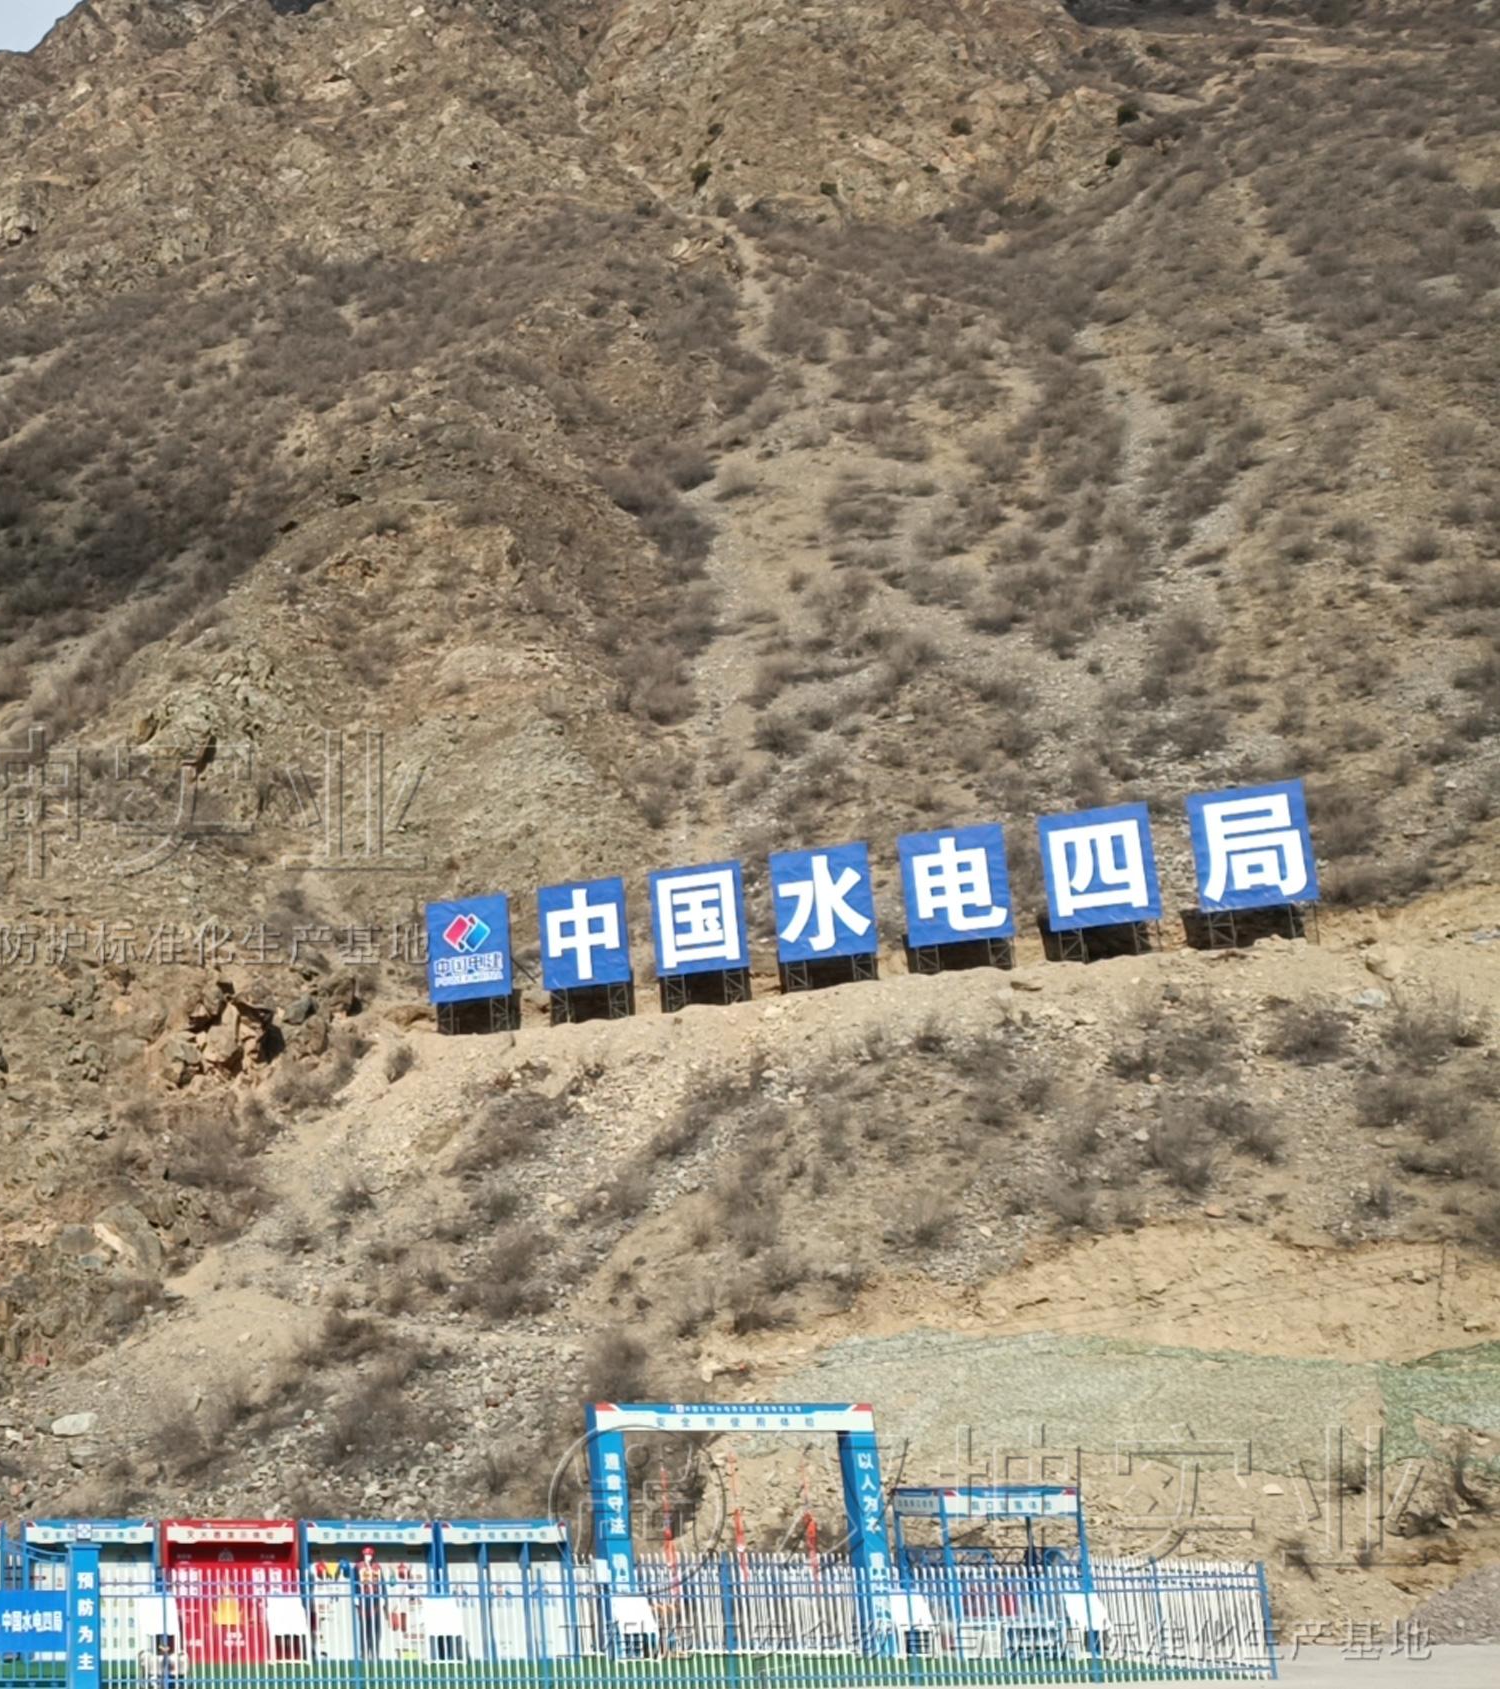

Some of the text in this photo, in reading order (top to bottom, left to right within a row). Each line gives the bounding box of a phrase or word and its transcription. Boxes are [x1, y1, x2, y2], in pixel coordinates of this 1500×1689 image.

[546, 793, 1308, 980] 中国水电四局
[858, 1453, 882, 1534] 以人为本
[2, 1609, 63, 1633] 中国水电四局
[77, 1572, 94, 1671] 预防为主
